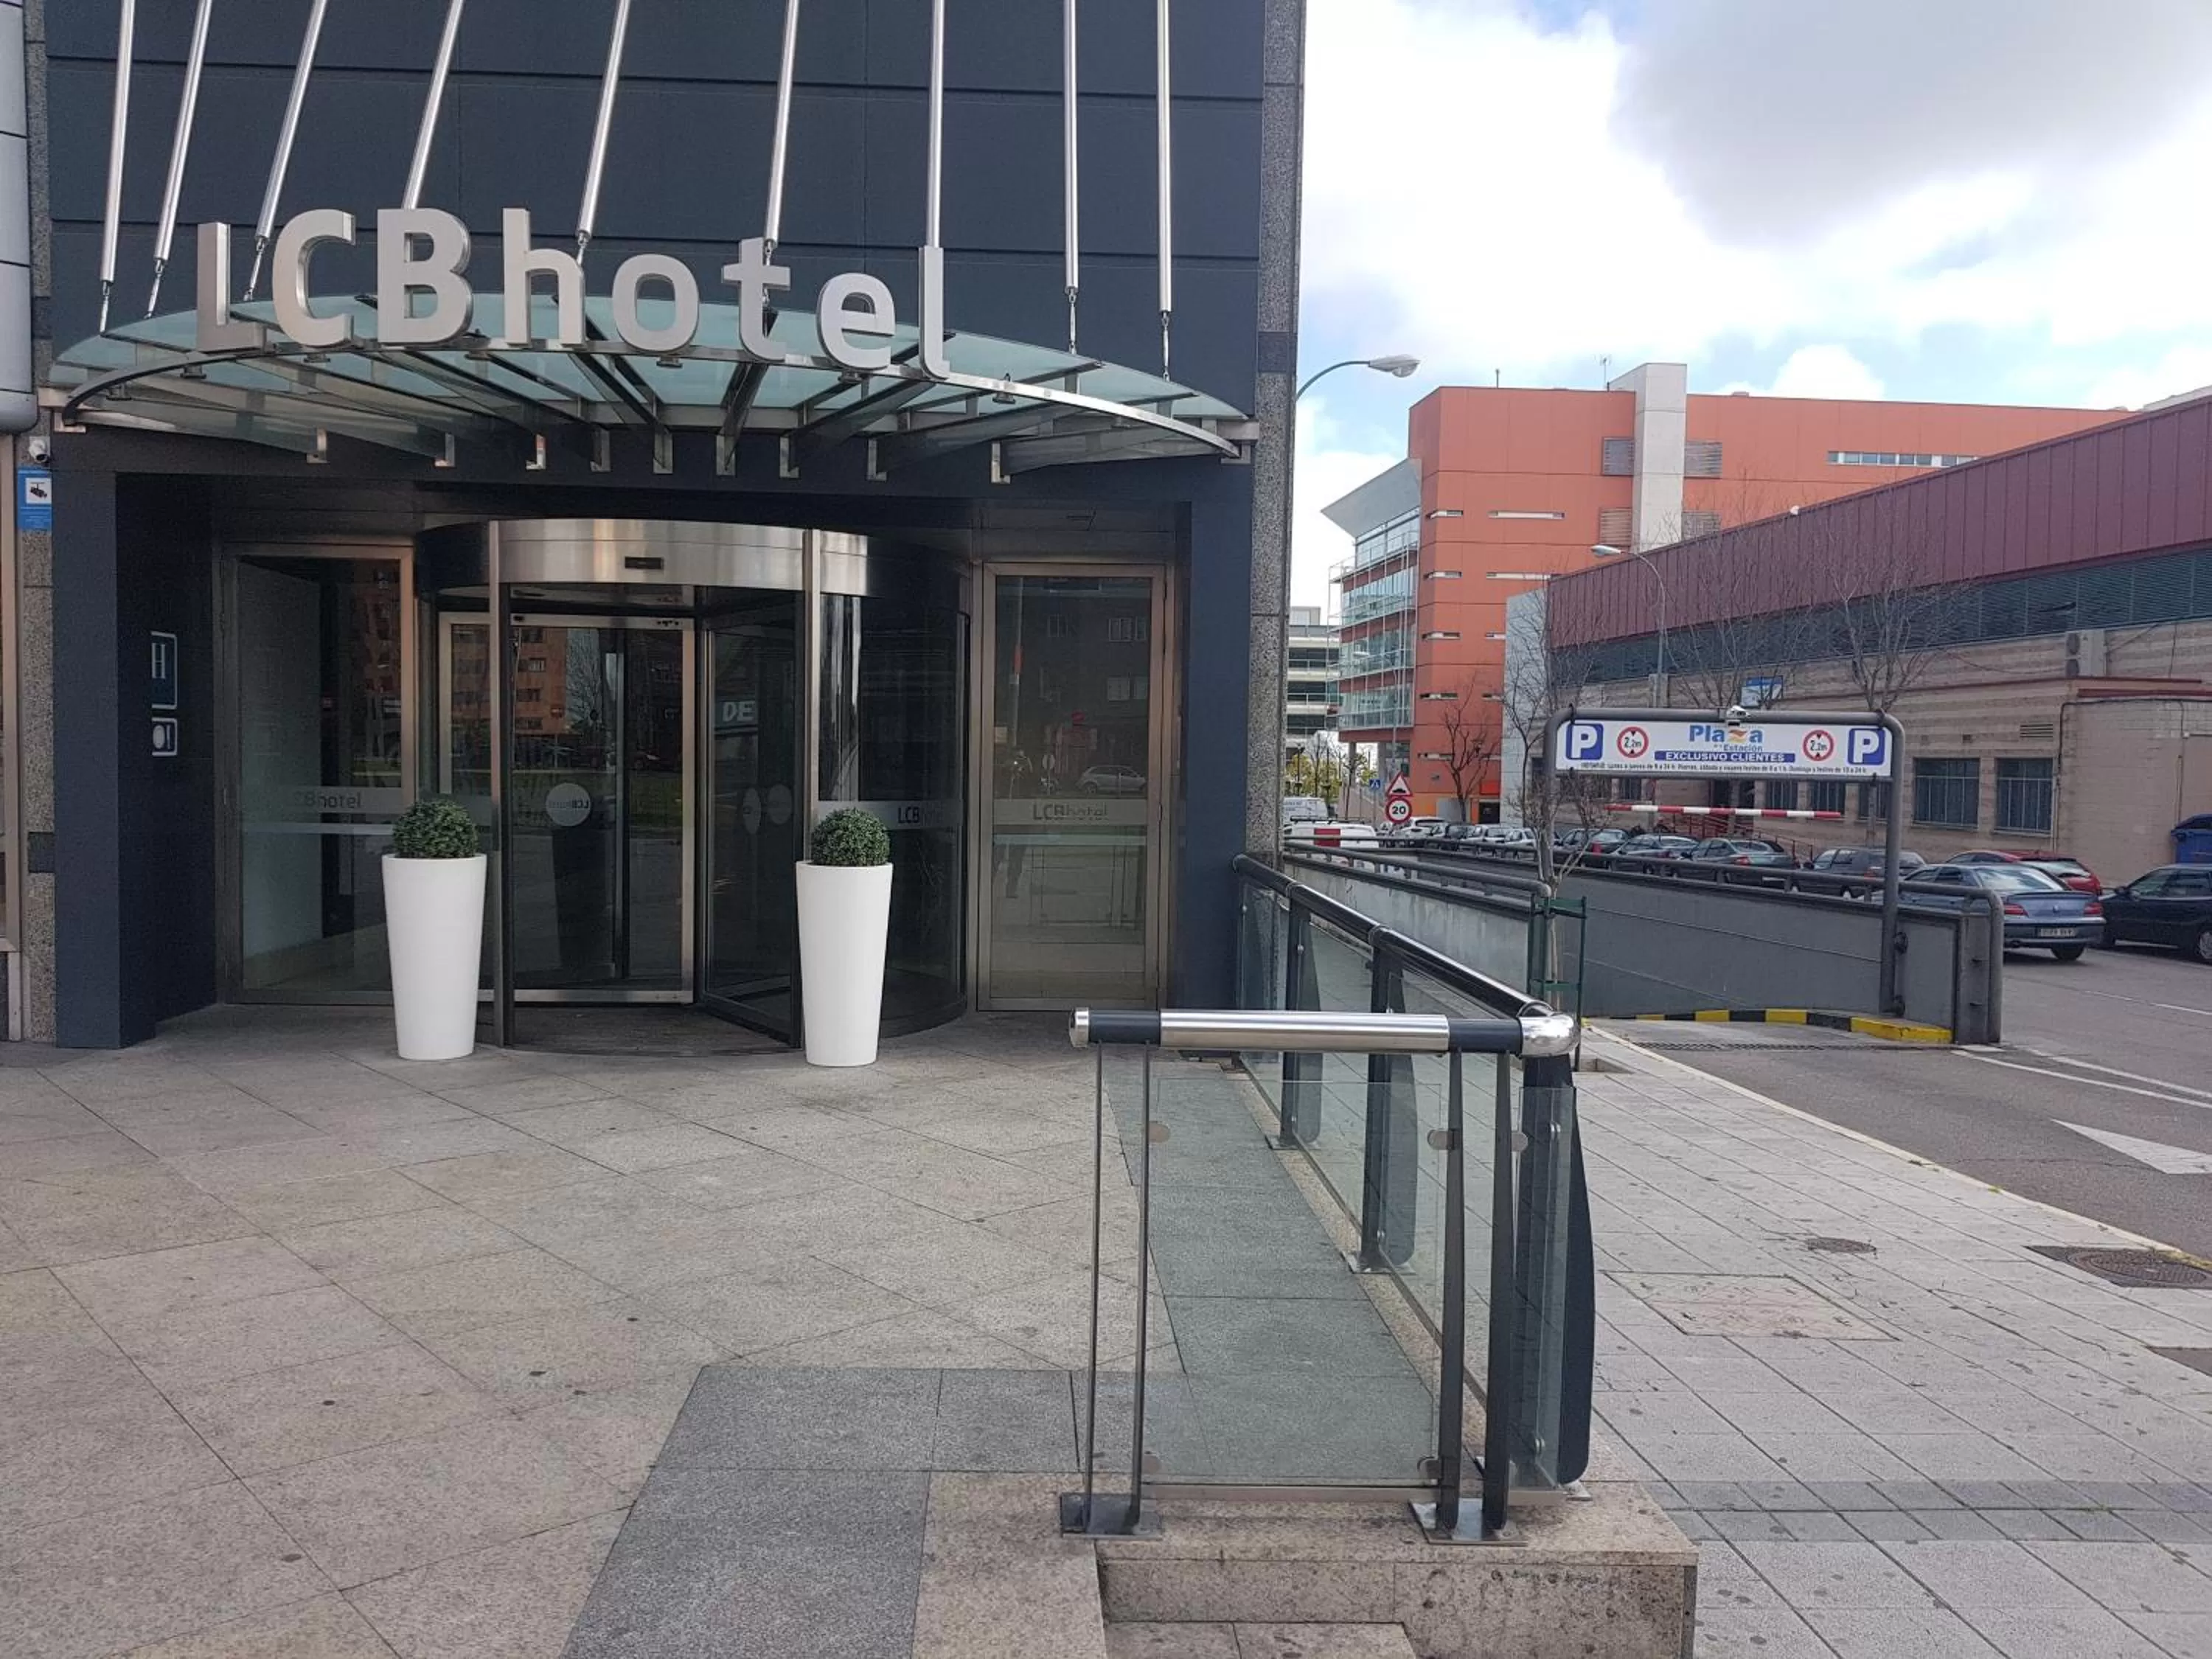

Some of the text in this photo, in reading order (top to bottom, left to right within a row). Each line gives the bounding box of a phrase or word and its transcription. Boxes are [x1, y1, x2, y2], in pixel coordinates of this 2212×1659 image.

[1571, 725, 1597, 758] P
[1854, 730, 1879, 763] P
[1666, 751, 1785, 762] EXCLUSIVO CLIENTES
[1392, 806, 1406, 815] 20
